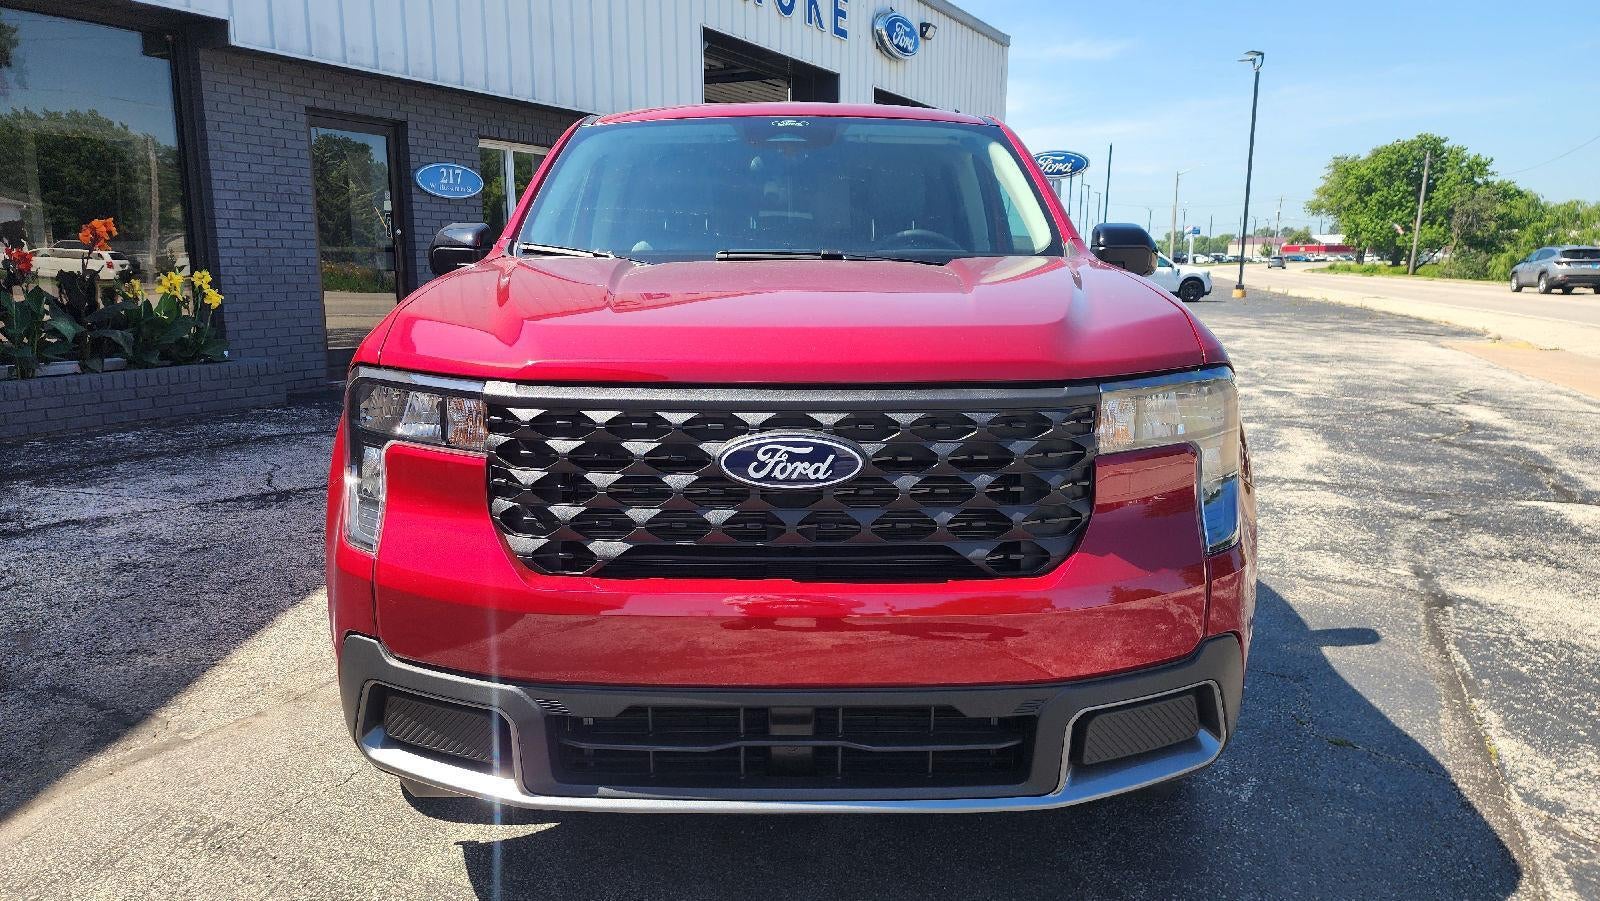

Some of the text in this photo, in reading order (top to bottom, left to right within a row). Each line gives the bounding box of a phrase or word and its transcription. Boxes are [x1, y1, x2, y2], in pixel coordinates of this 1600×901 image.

[893, 21, 915, 52] Ford
[440, 167, 462, 185] 217
[1037, 155, 1075, 173] Ford
[747, 444, 836, 480] Ford
